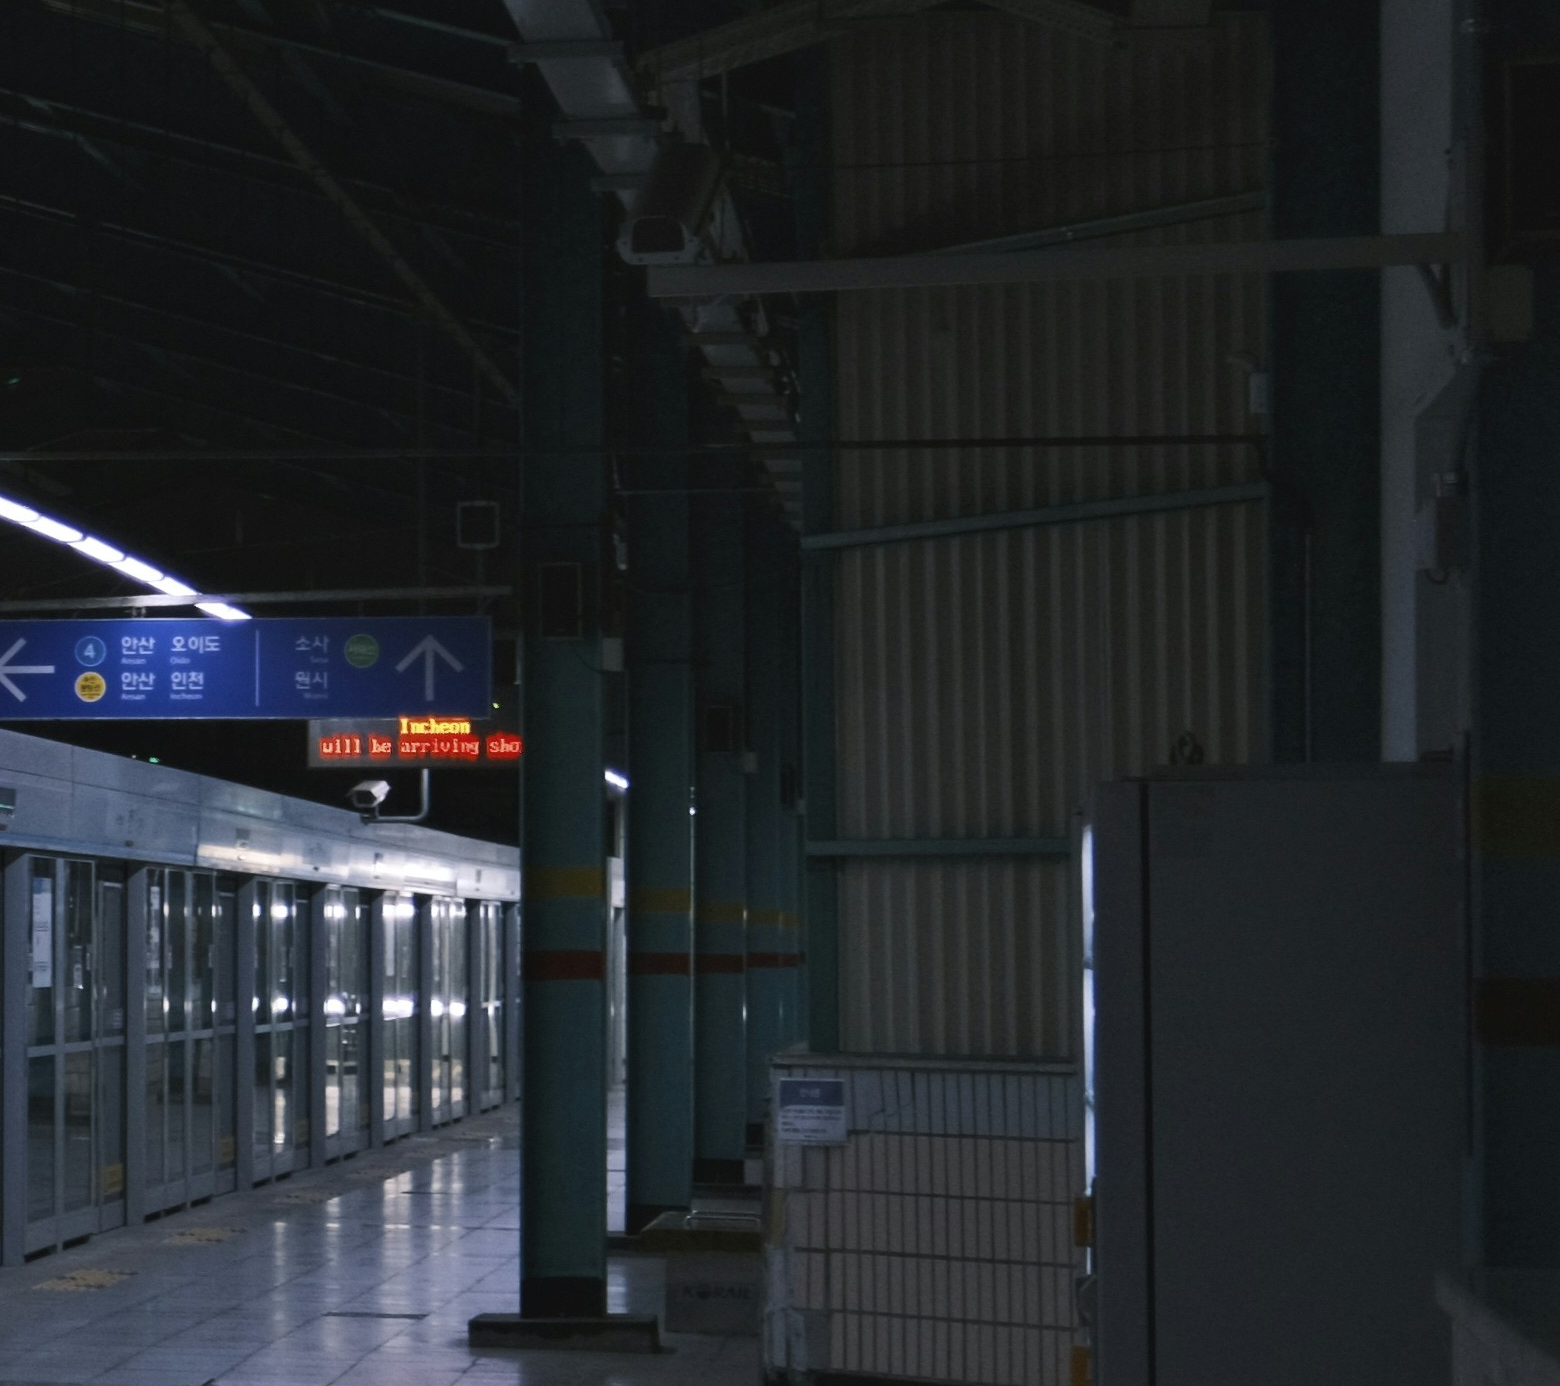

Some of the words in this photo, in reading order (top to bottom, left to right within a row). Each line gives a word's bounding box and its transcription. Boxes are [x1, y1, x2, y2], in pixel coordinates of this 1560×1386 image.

[83, 643, 94, 659] 4
[121, 636, 155, 654] 안산
[171, 636, 221, 654] 오이도
[295, 635, 330, 654] 소사
[121, 671, 155, 690] 안산
[171, 671, 204, 690] 인천
[294, 671, 328, 690] 원시
[399, 717, 471, 734] Incheon
[371, 738, 392, 754] be
[400, 737, 480, 756] arriving
